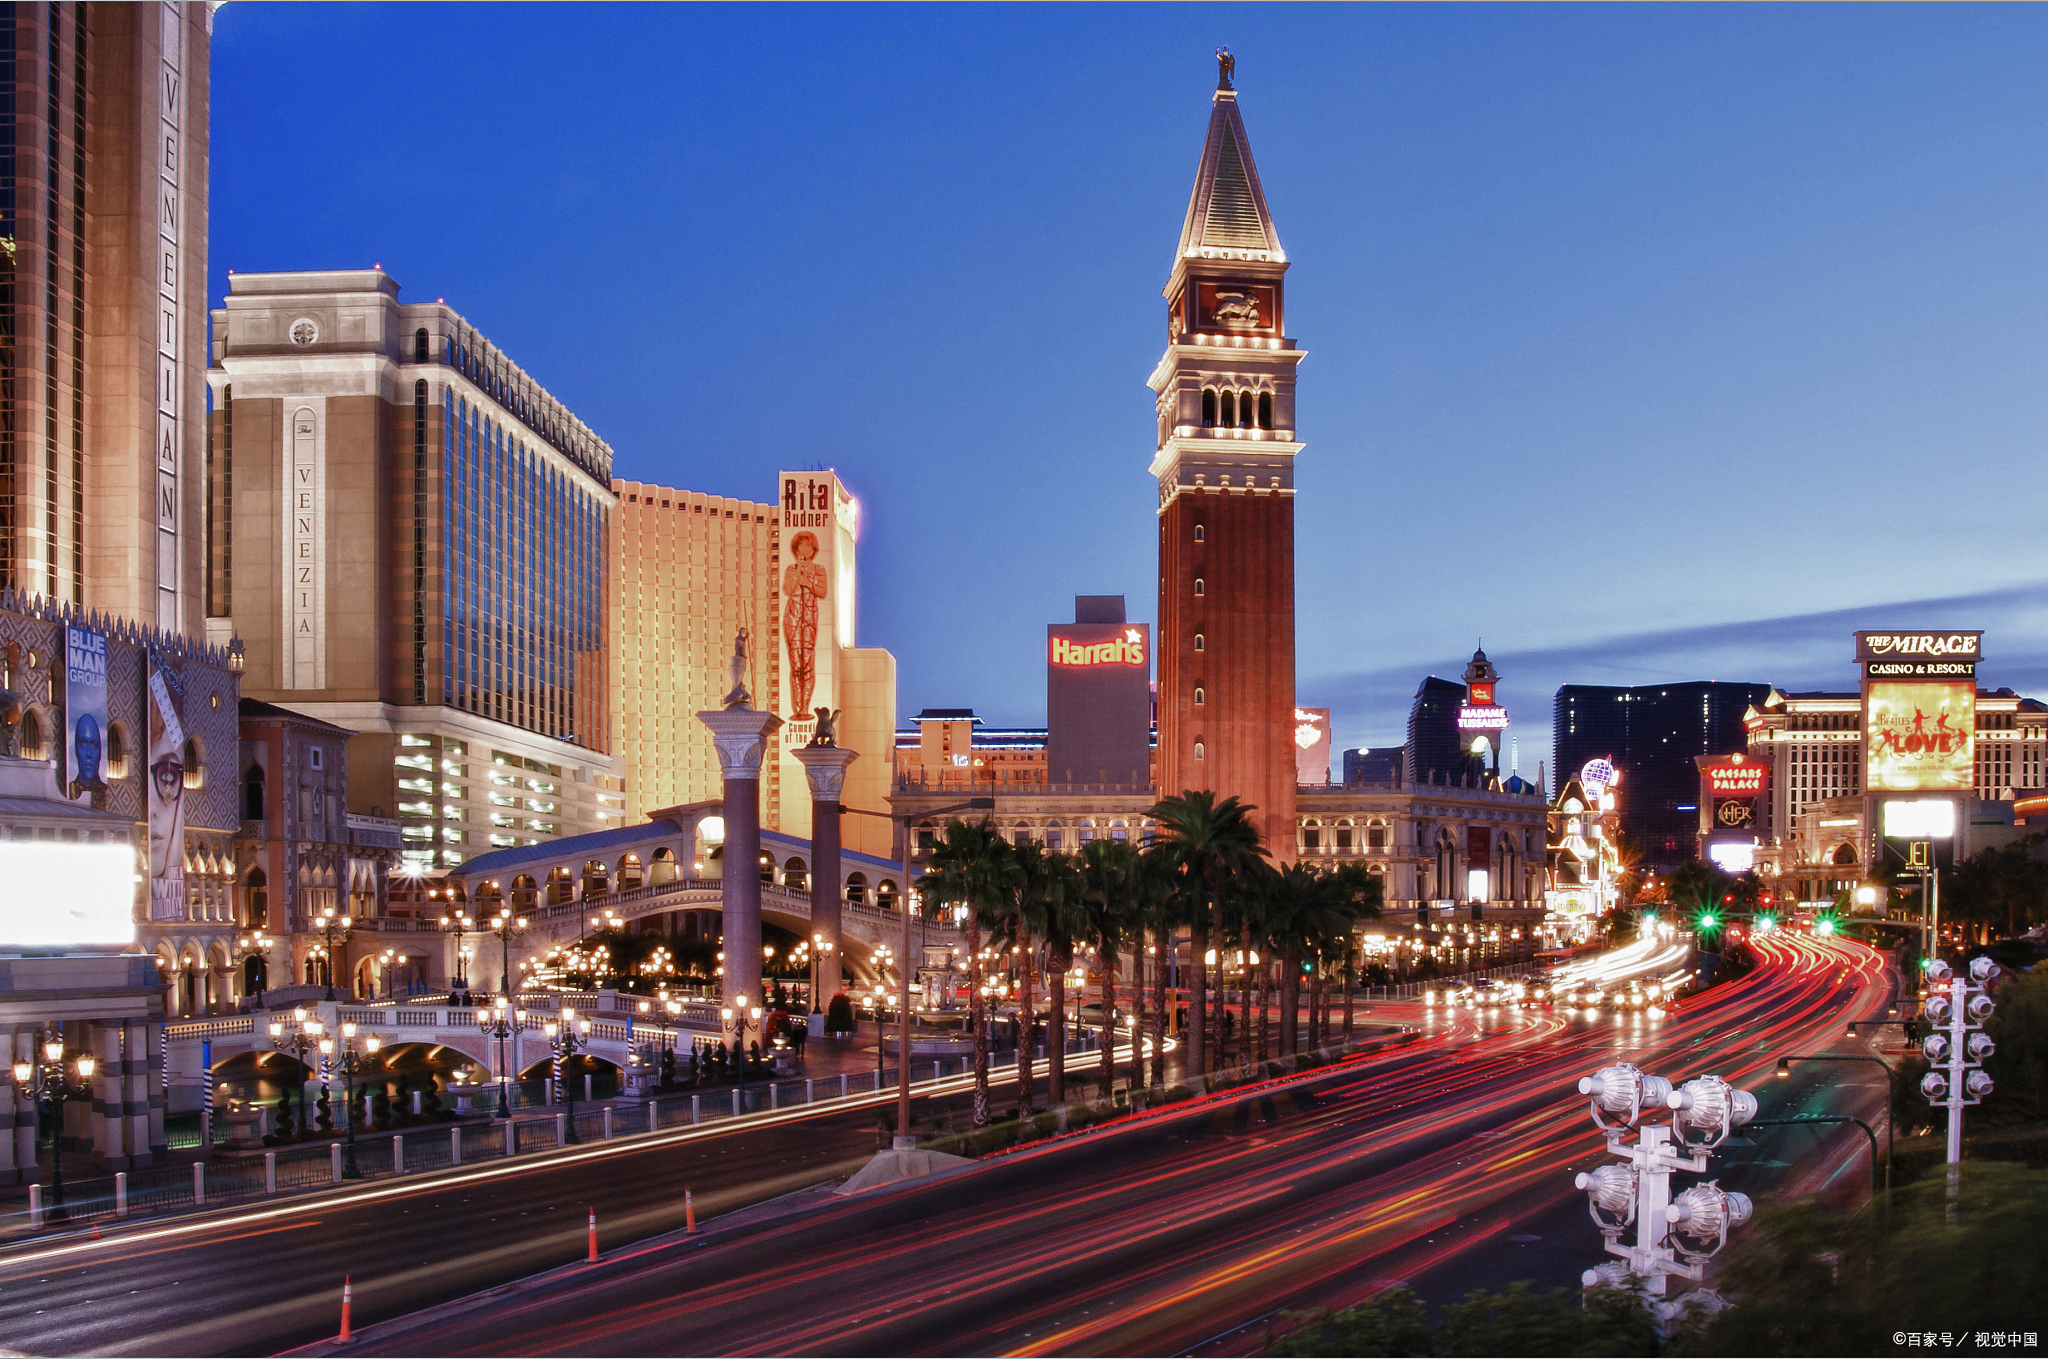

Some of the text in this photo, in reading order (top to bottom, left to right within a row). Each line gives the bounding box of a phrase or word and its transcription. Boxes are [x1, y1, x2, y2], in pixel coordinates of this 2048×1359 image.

[162, 71, 178, 520] VENETIAN
[297, 424, 312, 434] The
[785, 479, 828, 510] Rita
[785, 511, 828, 527] Rudner
[298, 468, 312, 633] VENEZIA
[70, 628, 105, 655] BLUE
[1866, 635, 1978, 656] THE MIRAGE
[70, 647, 106, 675] MAN
[1869, 664, 1974, 674] CASINO & RESORT
[70, 668, 106, 688] GROUP
[1458, 718, 1509, 728] TUSSAUDS
[1461, 709, 1506, 718] MADAME
[1880, 713, 1911, 726] BEATLES
[1893, 733, 1952, 753] LOVE
[1711, 769, 1762, 778] CAESARS
[1713, 780, 1760, 789] PALACE
[1718, 800, 1752, 826] CHER
[1906, 841, 1930, 865] JET
